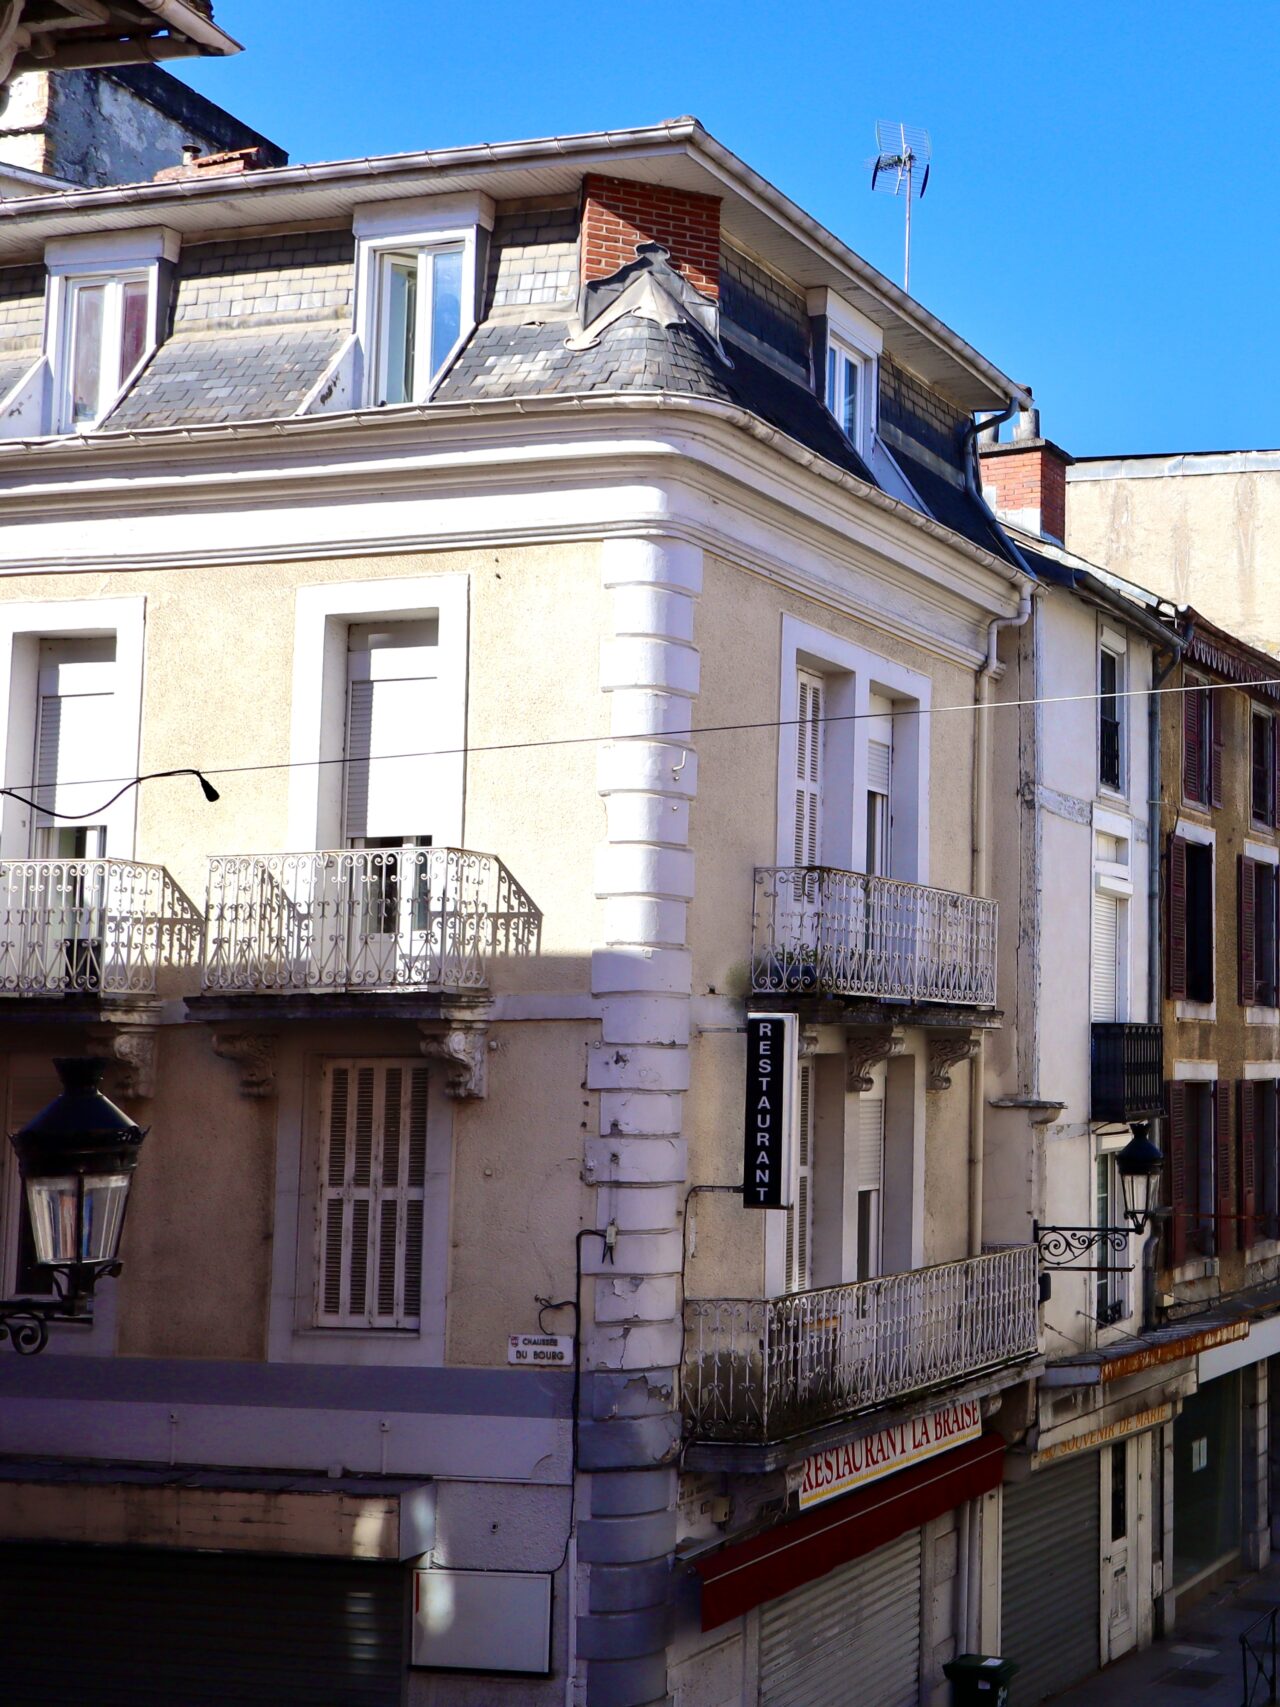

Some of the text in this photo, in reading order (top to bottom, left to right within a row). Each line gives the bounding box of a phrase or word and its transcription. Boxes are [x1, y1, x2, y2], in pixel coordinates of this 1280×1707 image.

[756, 1022, 772, 1202] RESTAURANT
[516, 1350, 565, 1360] DU BOURG
[801, 1400, 980, 1494] RESTAURANT LA BRAISE
[1061, 1424, 1115, 1454] SOUVENIR
[1120, 1418, 1132, 1433] DE
[1136, 1406, 1166, 1429] MARIE
